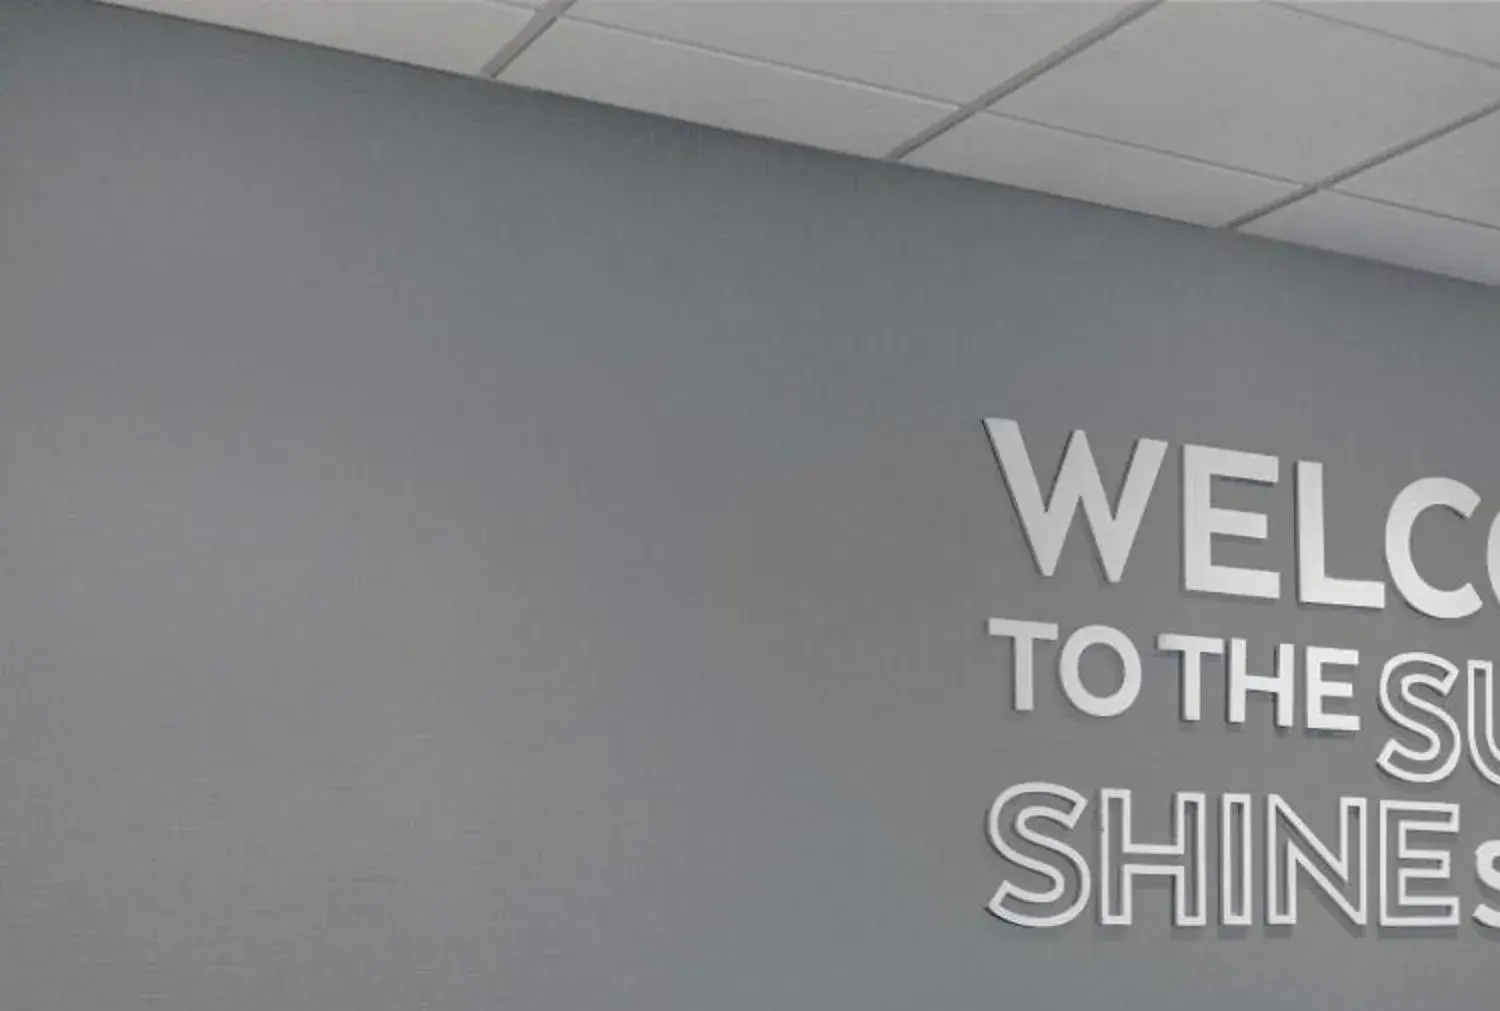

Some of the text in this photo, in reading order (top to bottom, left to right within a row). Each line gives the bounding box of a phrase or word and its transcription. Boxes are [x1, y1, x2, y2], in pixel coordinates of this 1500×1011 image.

[987, 617, 1143, 718] TO
[1156, 632, 1361, 732] THE
[984, 781, 1462, 930] SHINE
